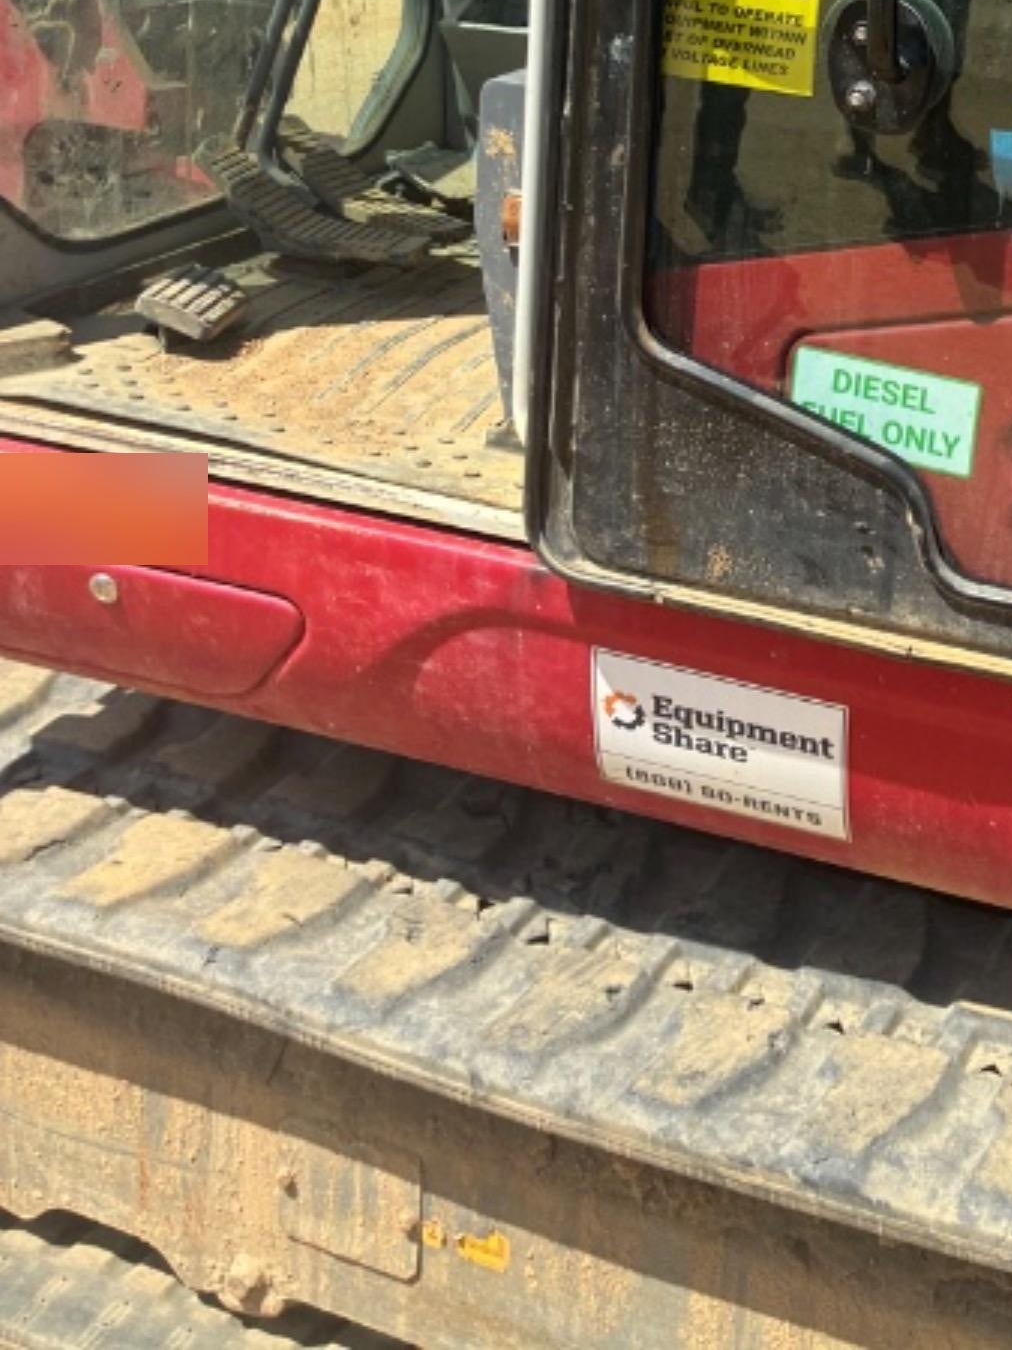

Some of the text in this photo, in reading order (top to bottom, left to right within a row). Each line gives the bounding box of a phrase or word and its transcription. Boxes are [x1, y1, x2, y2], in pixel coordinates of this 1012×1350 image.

[833, 368, 936, 414] DIESEL
[882, 420, 961, 459] ONLY
[653, 696, 836, 759] Equipment
[653, 723, 749, 763] Share
